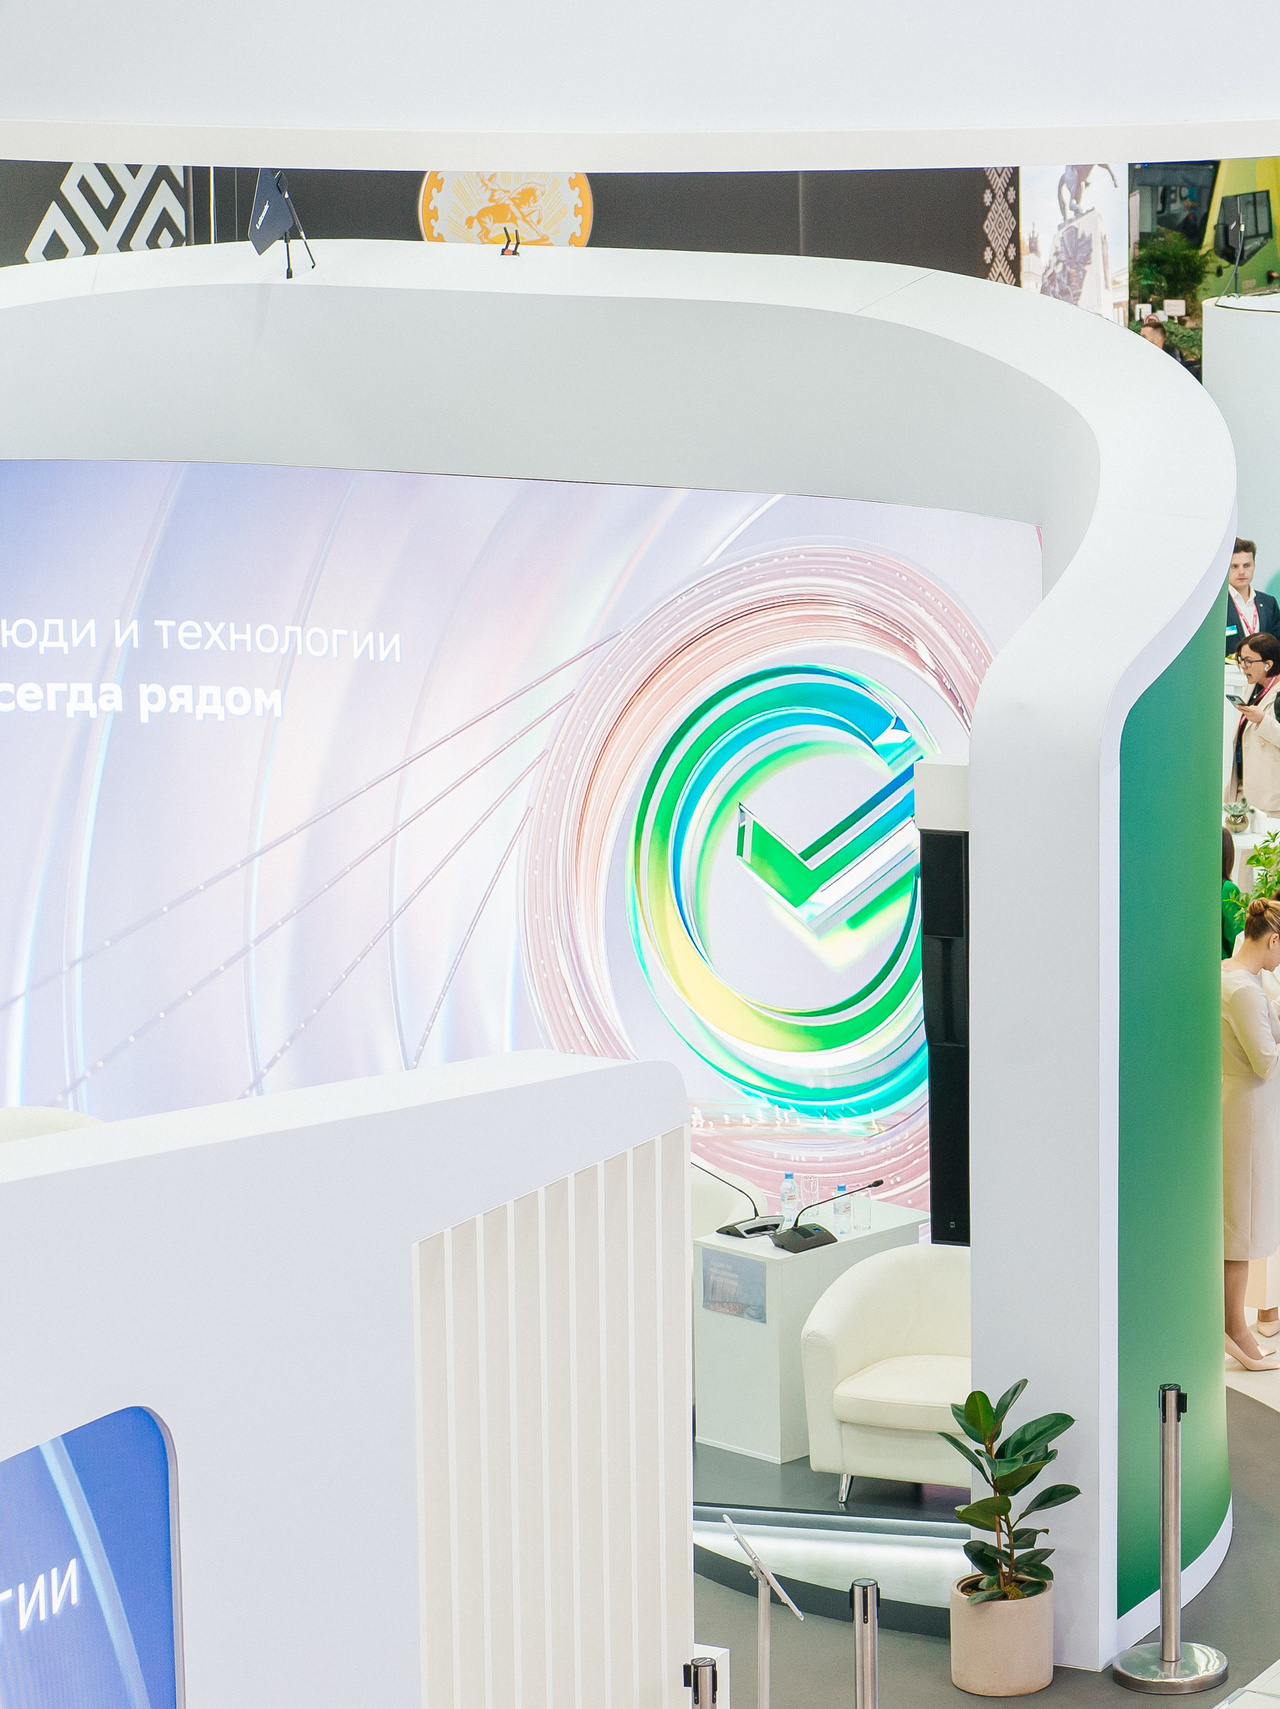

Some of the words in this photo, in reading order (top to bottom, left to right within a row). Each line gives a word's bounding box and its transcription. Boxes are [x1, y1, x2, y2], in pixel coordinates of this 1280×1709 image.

[114, 619, 139, 649] и
[154, 619, 401, 663] технологии
[0, 681, 124, 718] сегда
[139, 682, 283, 724] рядом
[0, 1557, 78, 1632] ии
